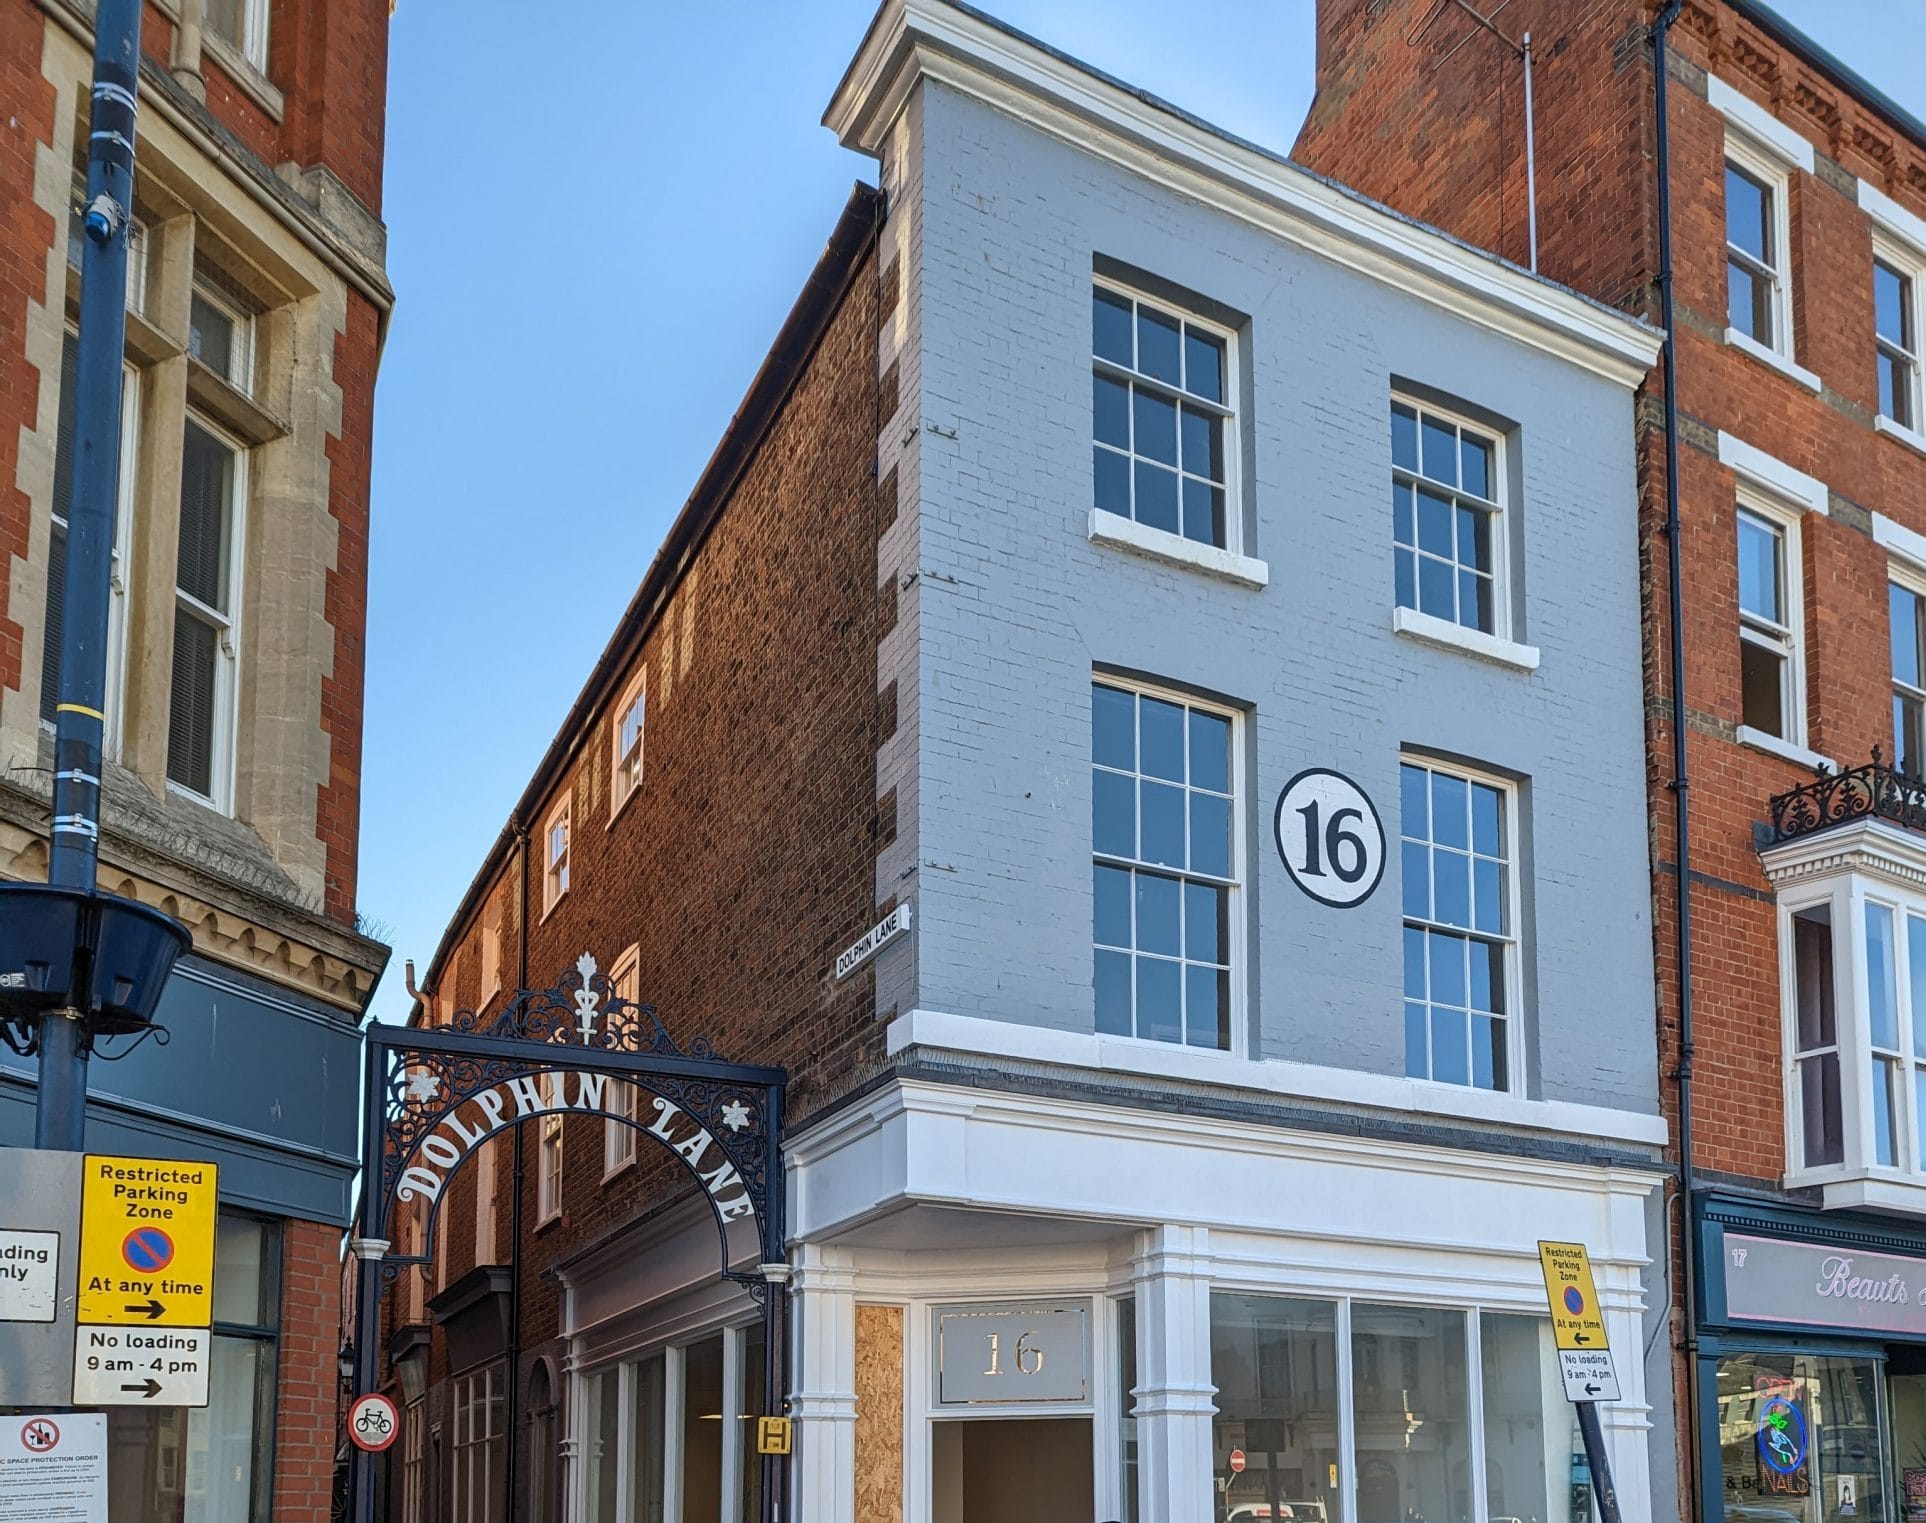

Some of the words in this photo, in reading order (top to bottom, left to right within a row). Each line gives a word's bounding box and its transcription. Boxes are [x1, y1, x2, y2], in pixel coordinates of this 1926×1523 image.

[1295, 799, 1368, 883] 16
[839, 934, 872, 974] DOLPHIN
[875, 913, 897, 943] LANE
[397, 1071, 607, 1204] DOLPHIN
[653, 1097, 755, 1224] LANE
[100, 1164, 203, 1184] Restricted
[114, 1184, 188, 1204] Parking
[126, 1203, 173, 1219] Zone
[1545, 1246, 1583, 1259] Restricted
[1731, 1248, 1747, 1267] 17
[1552, 1259, 1581, 1272] Parking
[1560, 1271, 1578, 1282] Zone
[88, 1277, 111, 1291] At
[119, 1281, 154, 1295] any
[161, 1280, 203, 1295] time
[1557, 1318, 1567, 1329] At
[1568, 1320, 1581, 1330] any
[1584, 1319, 1601, 1329] time
[90, 1333, 118, 1347] No
[126, 1334, 198, 1352] loading
[983, 1330, 1045, 1375] 16
[1565, 1354, 1577, 1364] No
[1578, 1354, 1608, 1366] loading
[87, 1356, 99, 1370] 9
[105, 1360, 133, 1371] am
[150, 1358, 163, 1371] 4
[169, 1361, 198, 1374] pm
[1567, 1370, 1573, 1379] 9
[1574, 1371, 1587, 1379] am
[1592, 1370, 1598, 1379] 4
[1600, 1372, 1612, 1380] pm
[763, 1421, 787, 1450] H
[30, 1455, 74, 1463] PROTECTION
[1726, 1475, 1737, 1489] &
